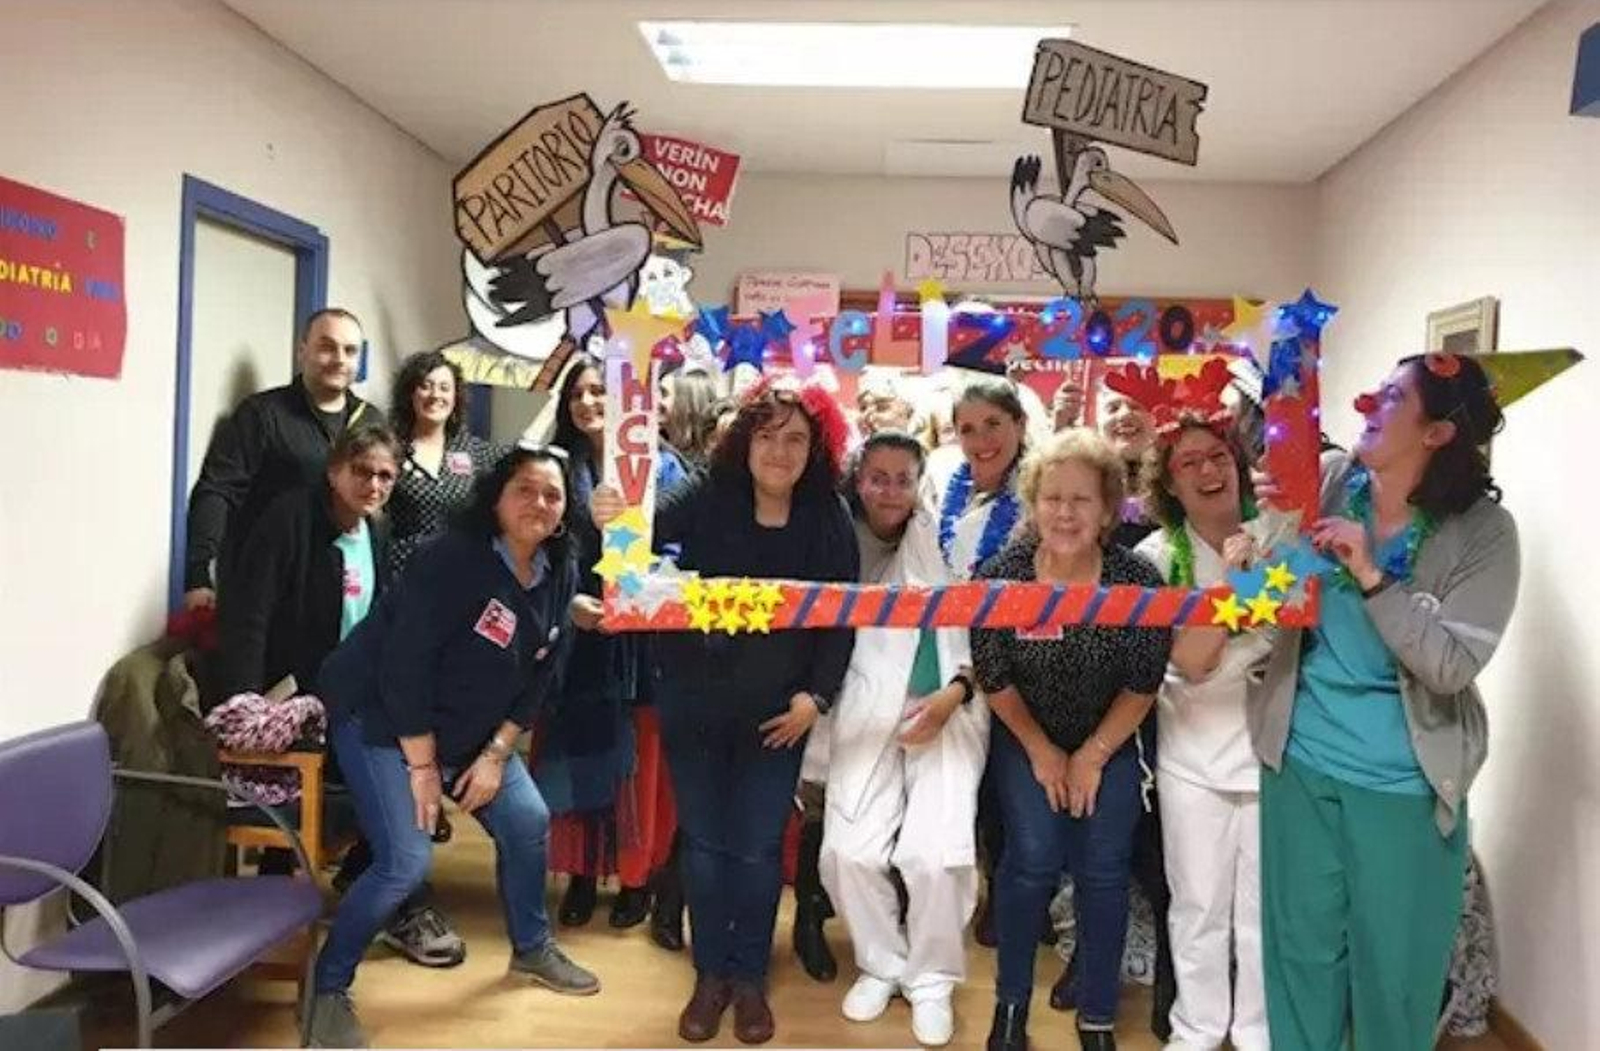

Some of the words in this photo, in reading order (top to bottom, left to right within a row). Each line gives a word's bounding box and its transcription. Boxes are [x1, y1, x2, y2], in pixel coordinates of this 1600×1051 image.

[656, 163, 707, 192] NON
[1042, 296, 1195, 361] 2020
[615, 360, 652, 506] HCV
